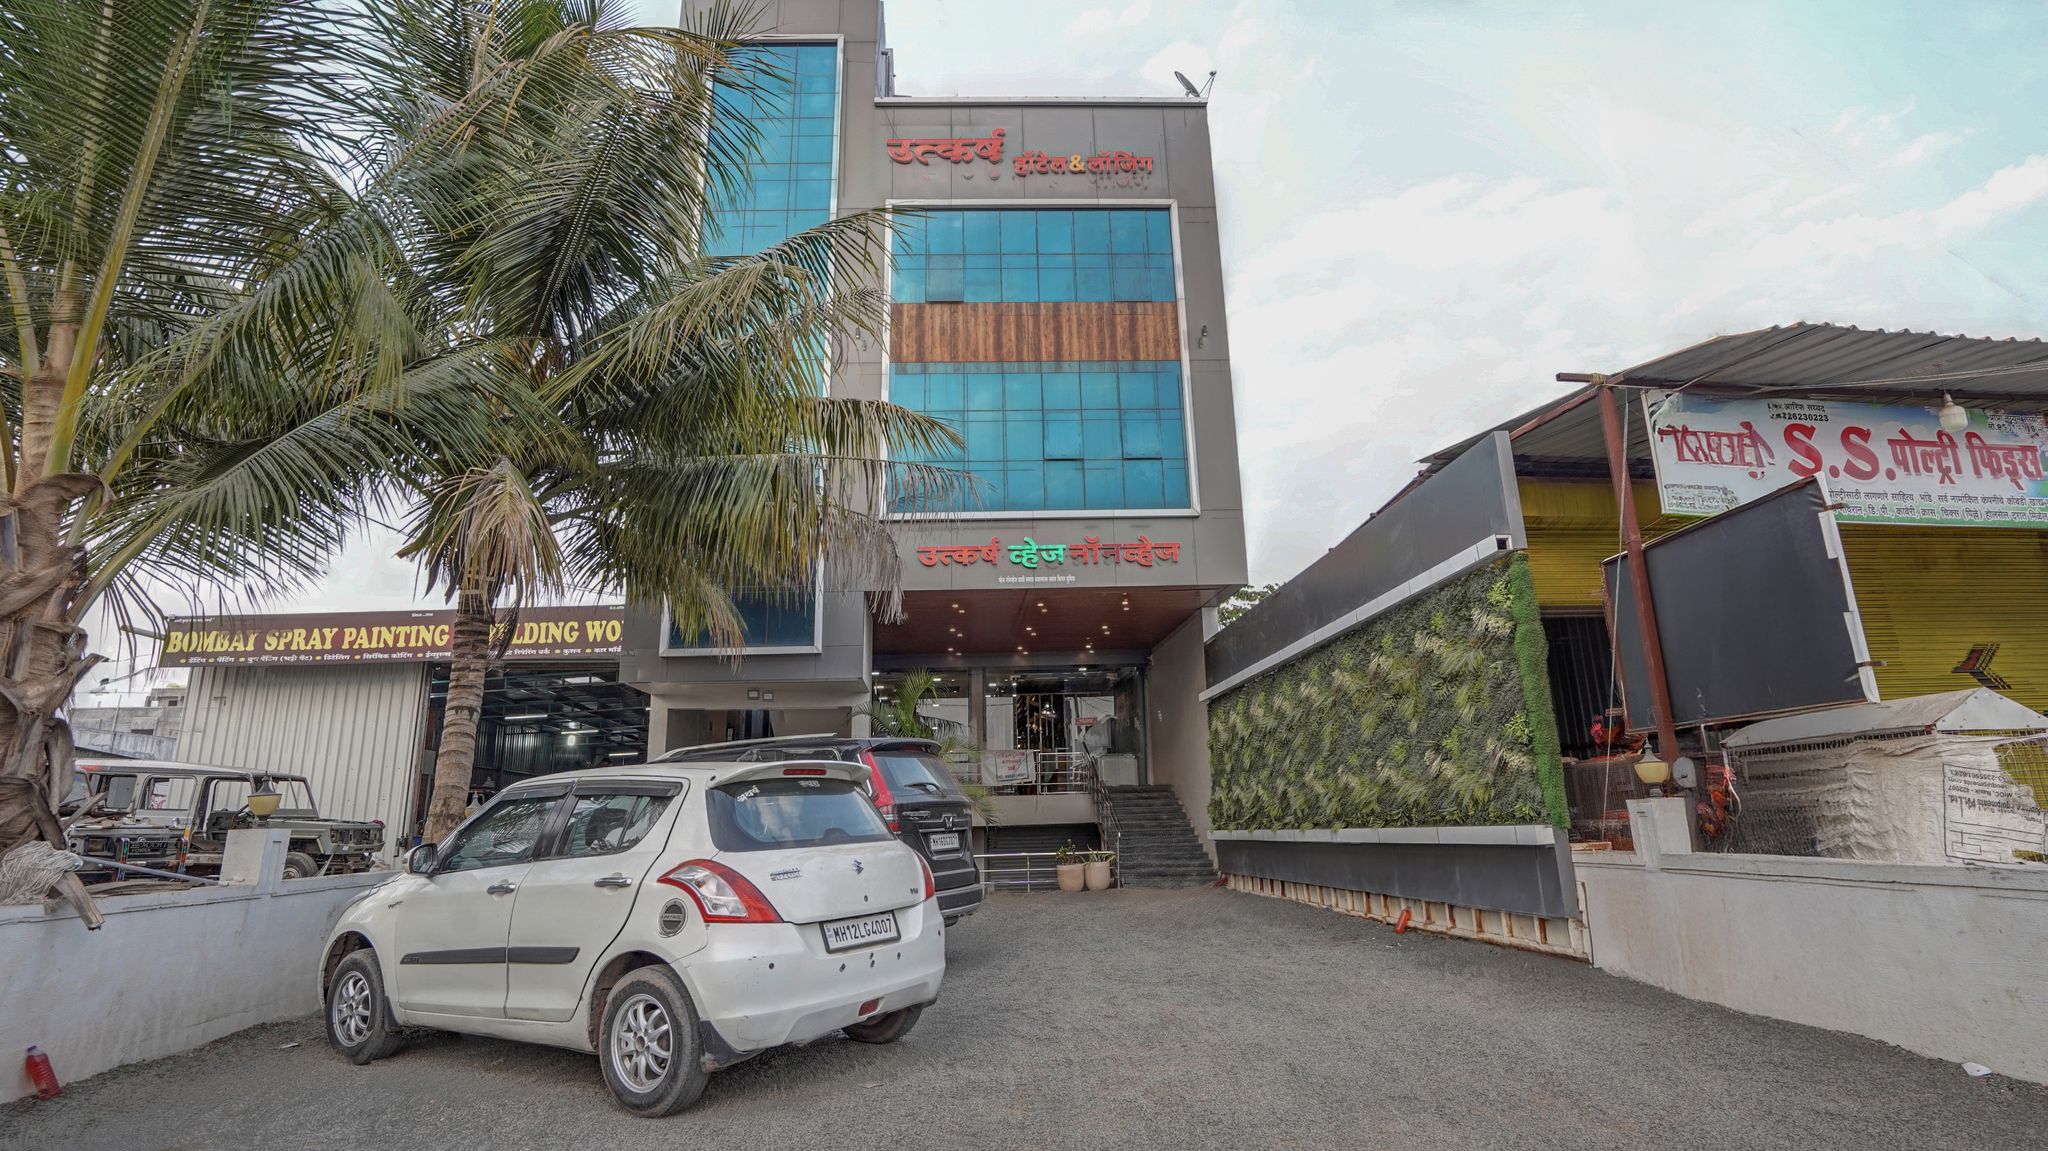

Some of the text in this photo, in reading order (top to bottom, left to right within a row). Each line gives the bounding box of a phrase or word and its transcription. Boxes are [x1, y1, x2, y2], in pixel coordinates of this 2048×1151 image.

[886, 128, 1005, 166] उत्कर्ष
[916, 536, 1000, 568] उत्कर्ष
[1007, 536, 1067, 569] व्हेज
[166, 630, 261, 653] BOMBAY
[264, 627, 339, 651] SPRAY
[341, 624, 450, 649] PAINTING
[585, 619, 625, 643] WO
[832, 917, 892, 944] MH12LG4007
